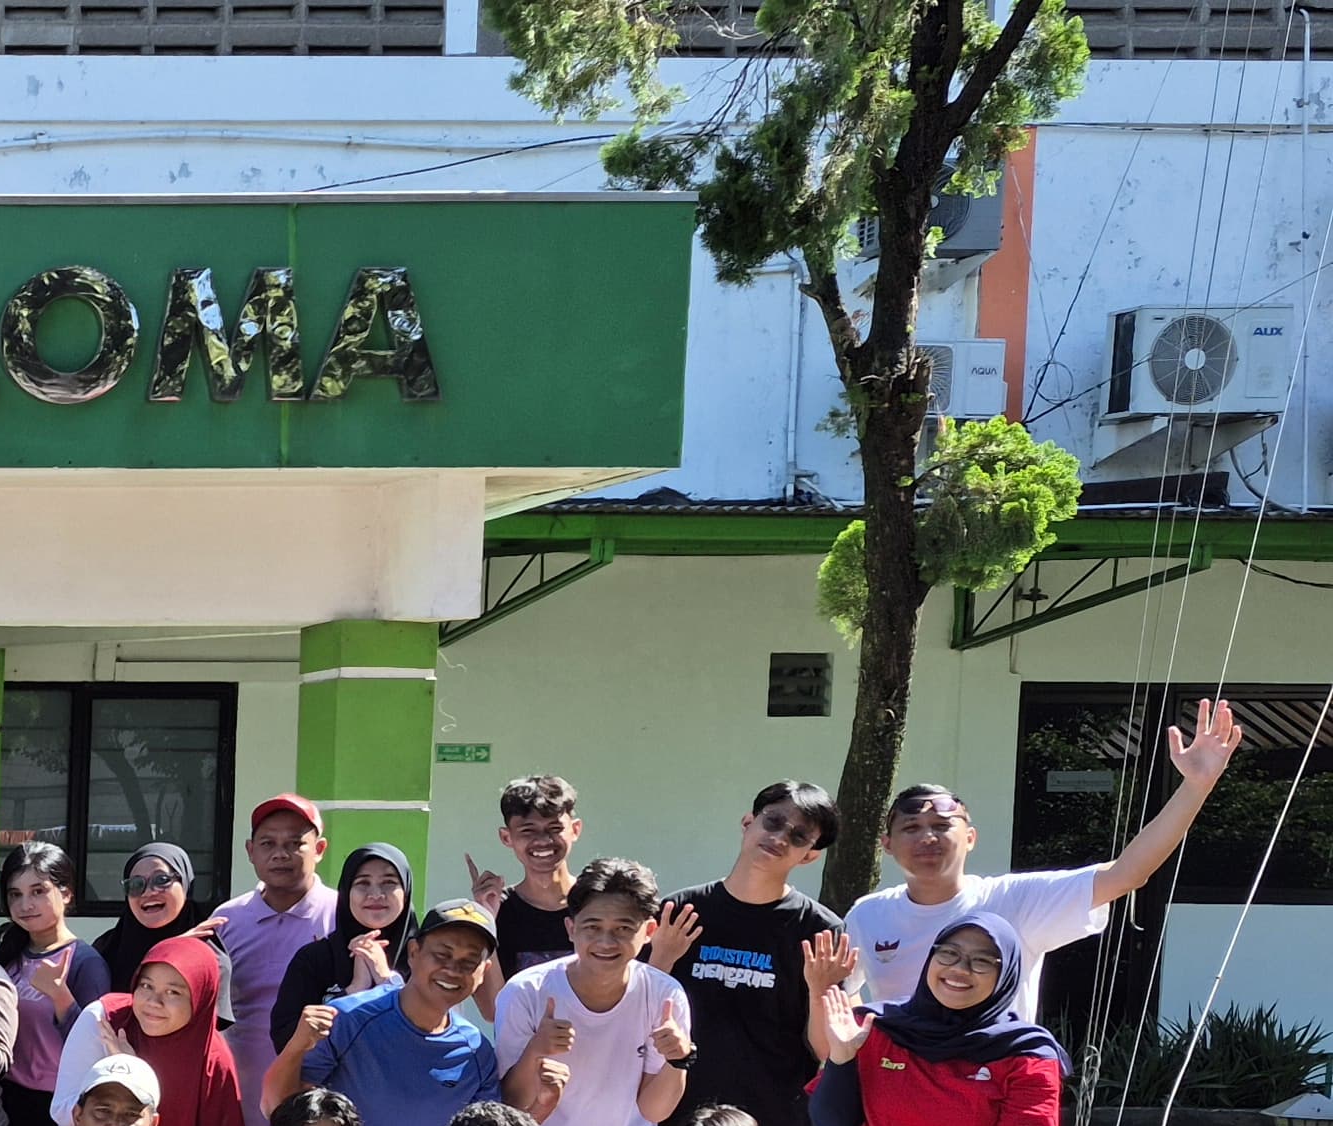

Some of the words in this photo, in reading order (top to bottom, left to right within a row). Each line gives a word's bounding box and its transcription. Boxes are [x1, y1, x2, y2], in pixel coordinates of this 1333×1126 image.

[1253, 327, 1283, 337] AUX
[971, 367, 997, 376] AQUA
[880, 1056, 906, 1071] Taro
